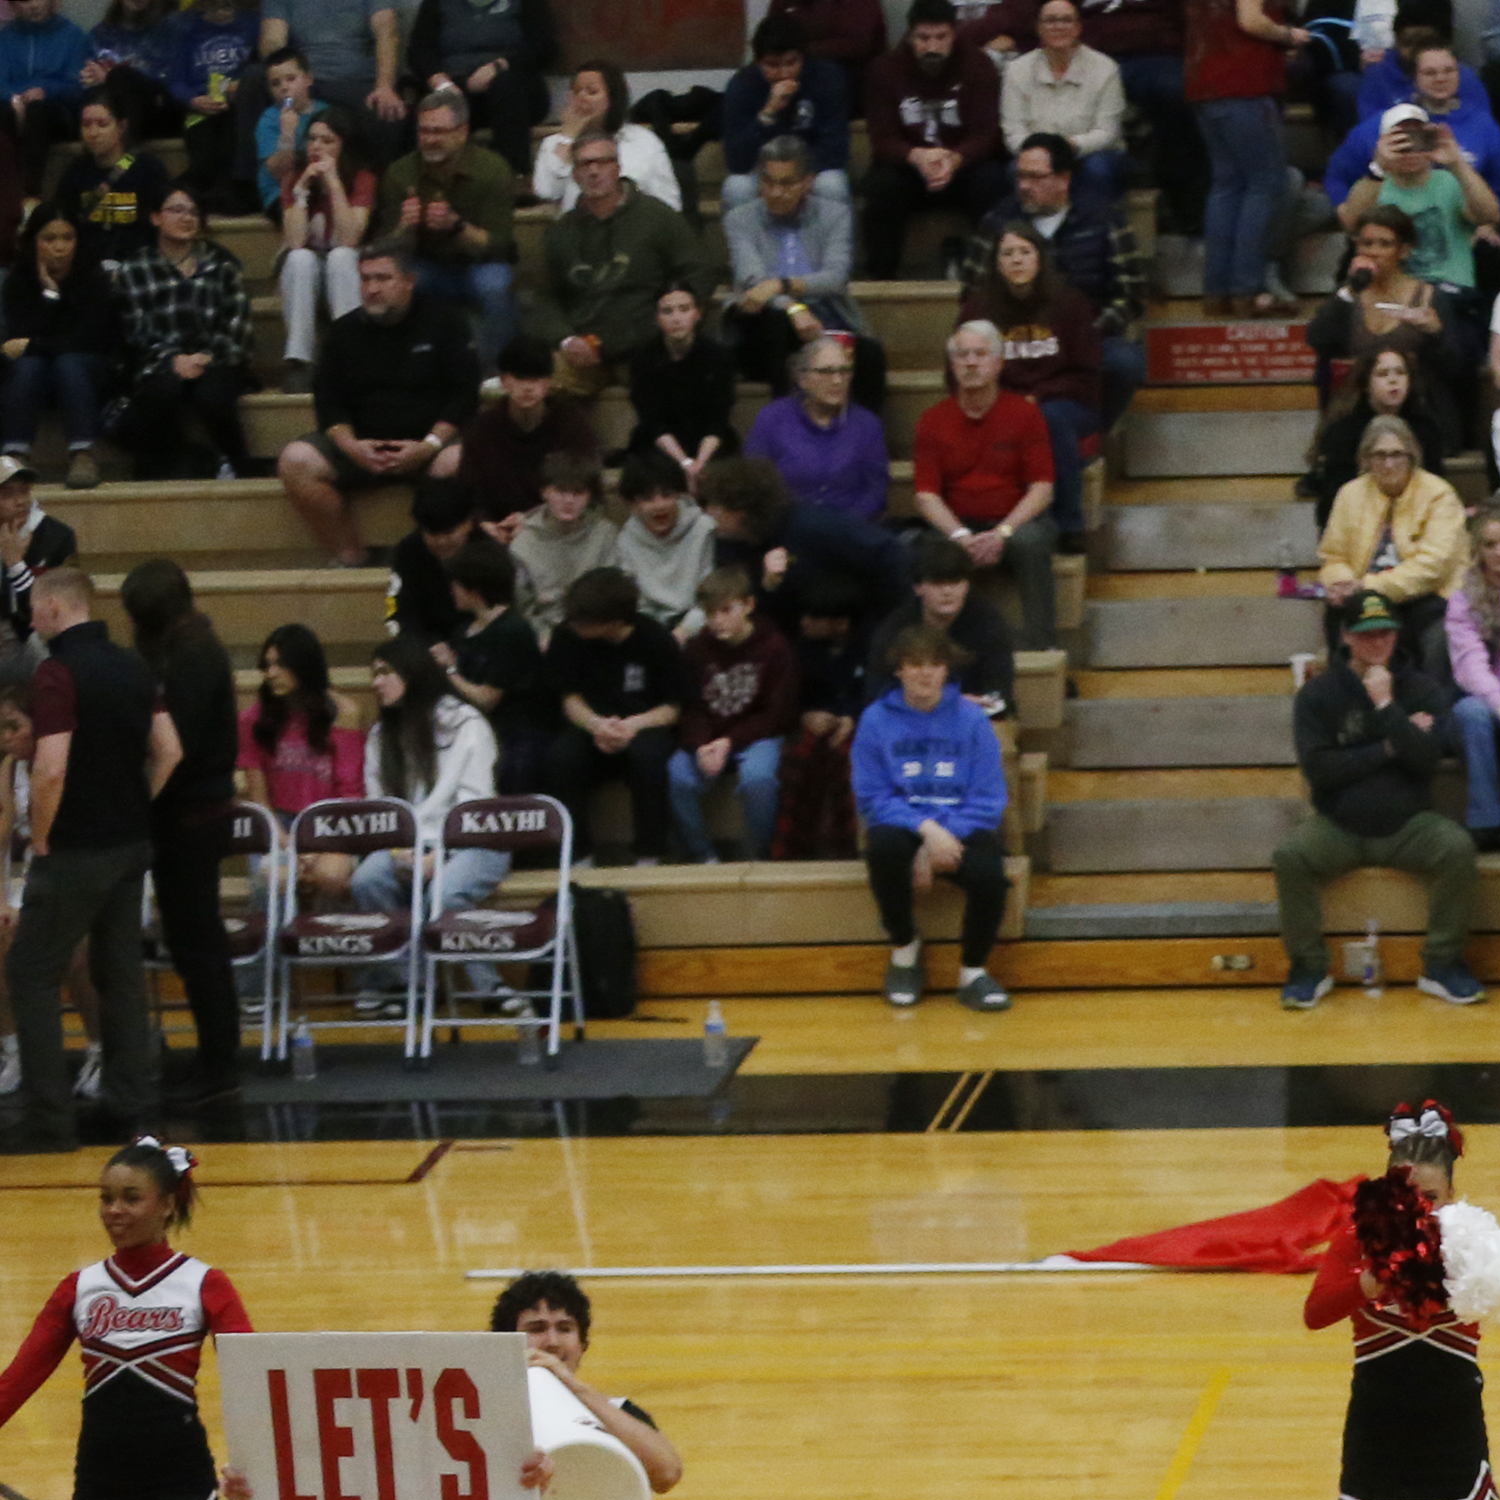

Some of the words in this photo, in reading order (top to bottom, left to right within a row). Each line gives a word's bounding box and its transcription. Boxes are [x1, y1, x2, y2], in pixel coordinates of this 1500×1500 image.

[313, 811, 399, 837] KAYHI
[461, 809, 548, 833] KAYHI
[297, 934, 374, 953] KINGS
[440, 931, 516, 950] KINGS
[82, 1293, 184, 1339] Bears
